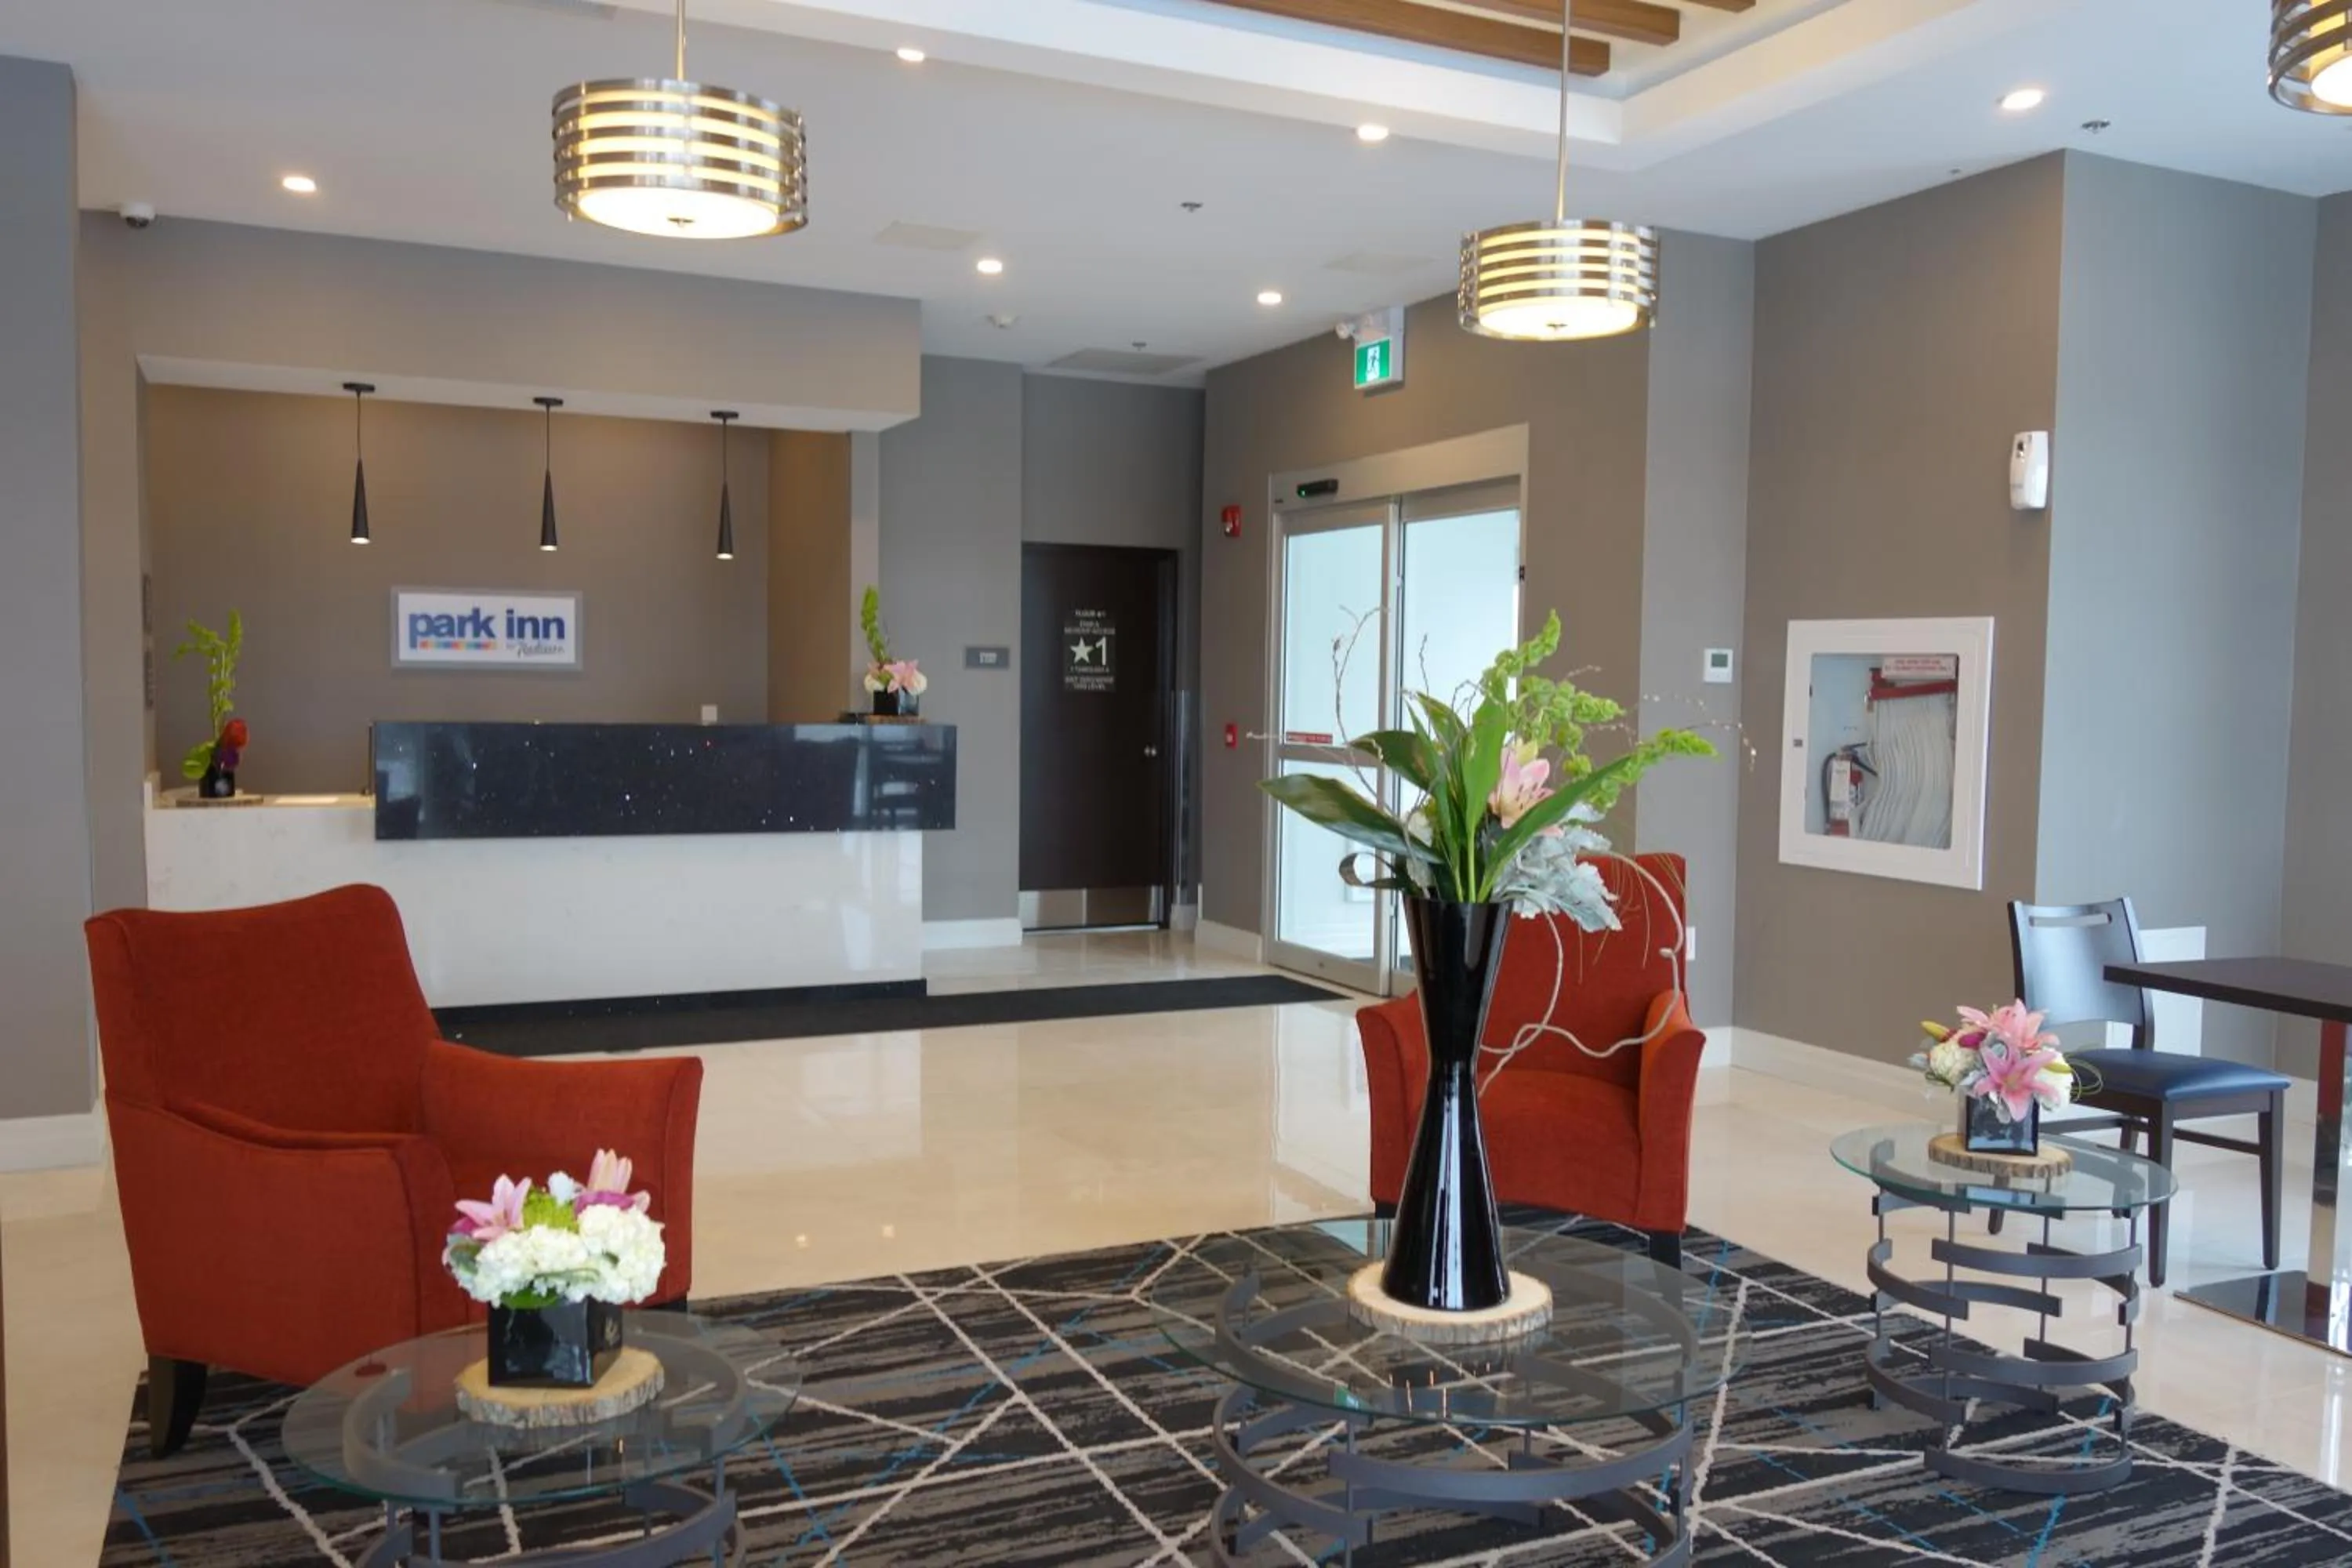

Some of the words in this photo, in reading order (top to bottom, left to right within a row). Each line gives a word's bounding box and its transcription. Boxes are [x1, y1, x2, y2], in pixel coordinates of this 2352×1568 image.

[408, 608, 495, 650] park
[506, 608, 565, 640] inn
[1095, 636, 1107, 666] 1
